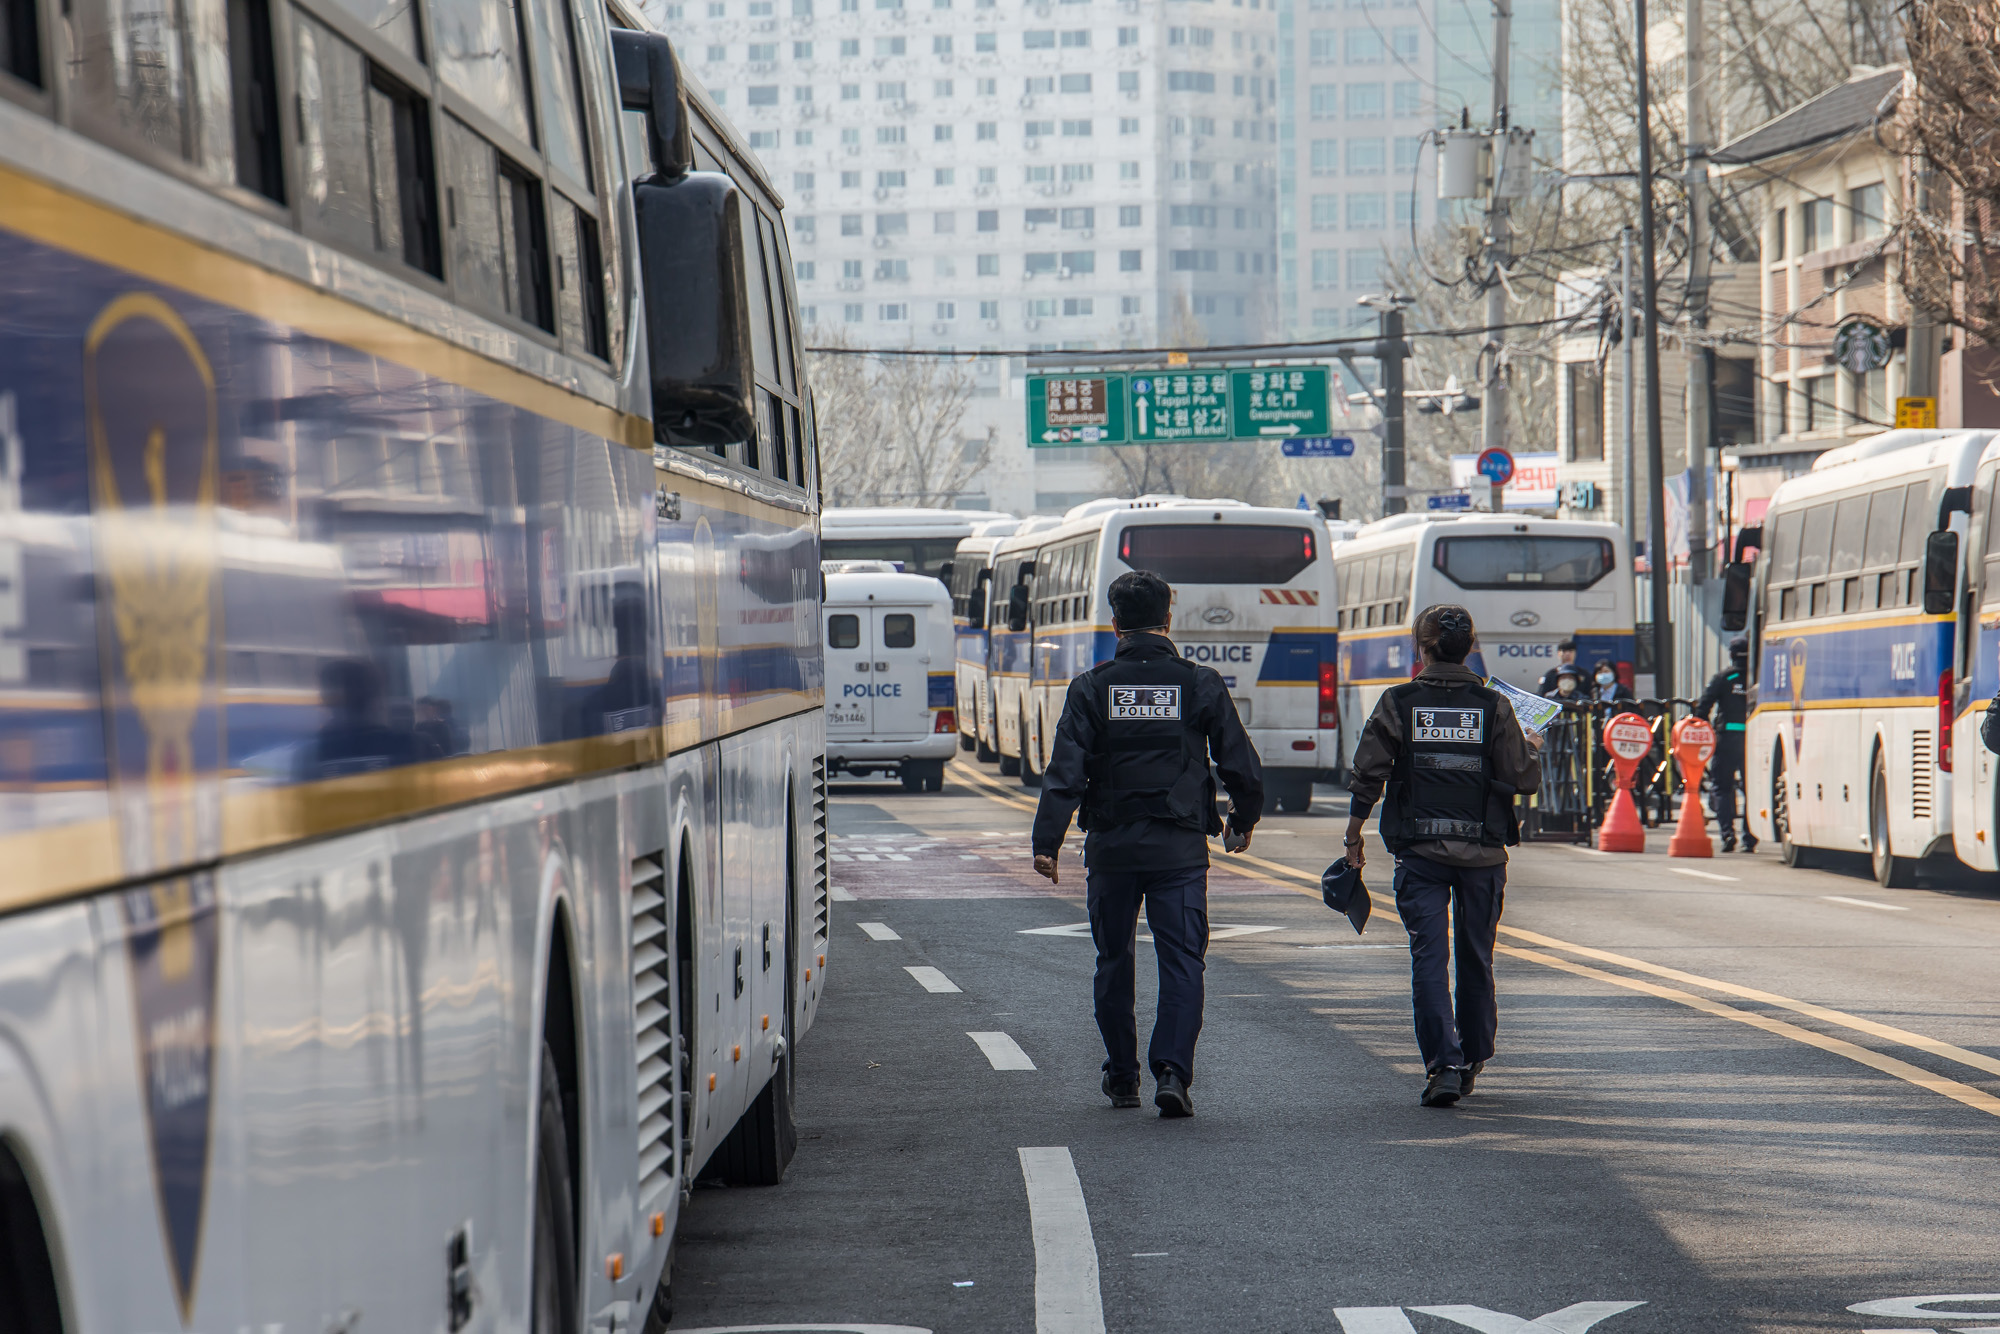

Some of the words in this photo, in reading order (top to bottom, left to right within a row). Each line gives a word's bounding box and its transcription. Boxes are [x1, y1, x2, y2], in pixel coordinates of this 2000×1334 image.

[1049, 379, 1092, 396] 창덕궁
[1153, 375, 1227, 395] 탑골공원
[1250, 372, 1306, 391] 광화문
[1154, 394, 1190, 407] Tapgol
[1192, 393, 1217, 406] Park
[1250, 391, 1297, 407] 光化門
[1154, 406, 1227, 427] 낙원상가
[1250, 409, 1314, 422] Gwanghwamun
[1155, 425, 1192, 438] Nagwon
[1194, 424, 1227, 436] Market
[1184, 645, 1252, 662] POLICE
[1499, 645, 1552, 658] POLICE
[1891, 642, 1916, 679] POLICE
[843, 683, 902, 698] POLICE
[1119, 706, 1171, 717] POLICE
[1421, 728, 1475, 739] POLICE
